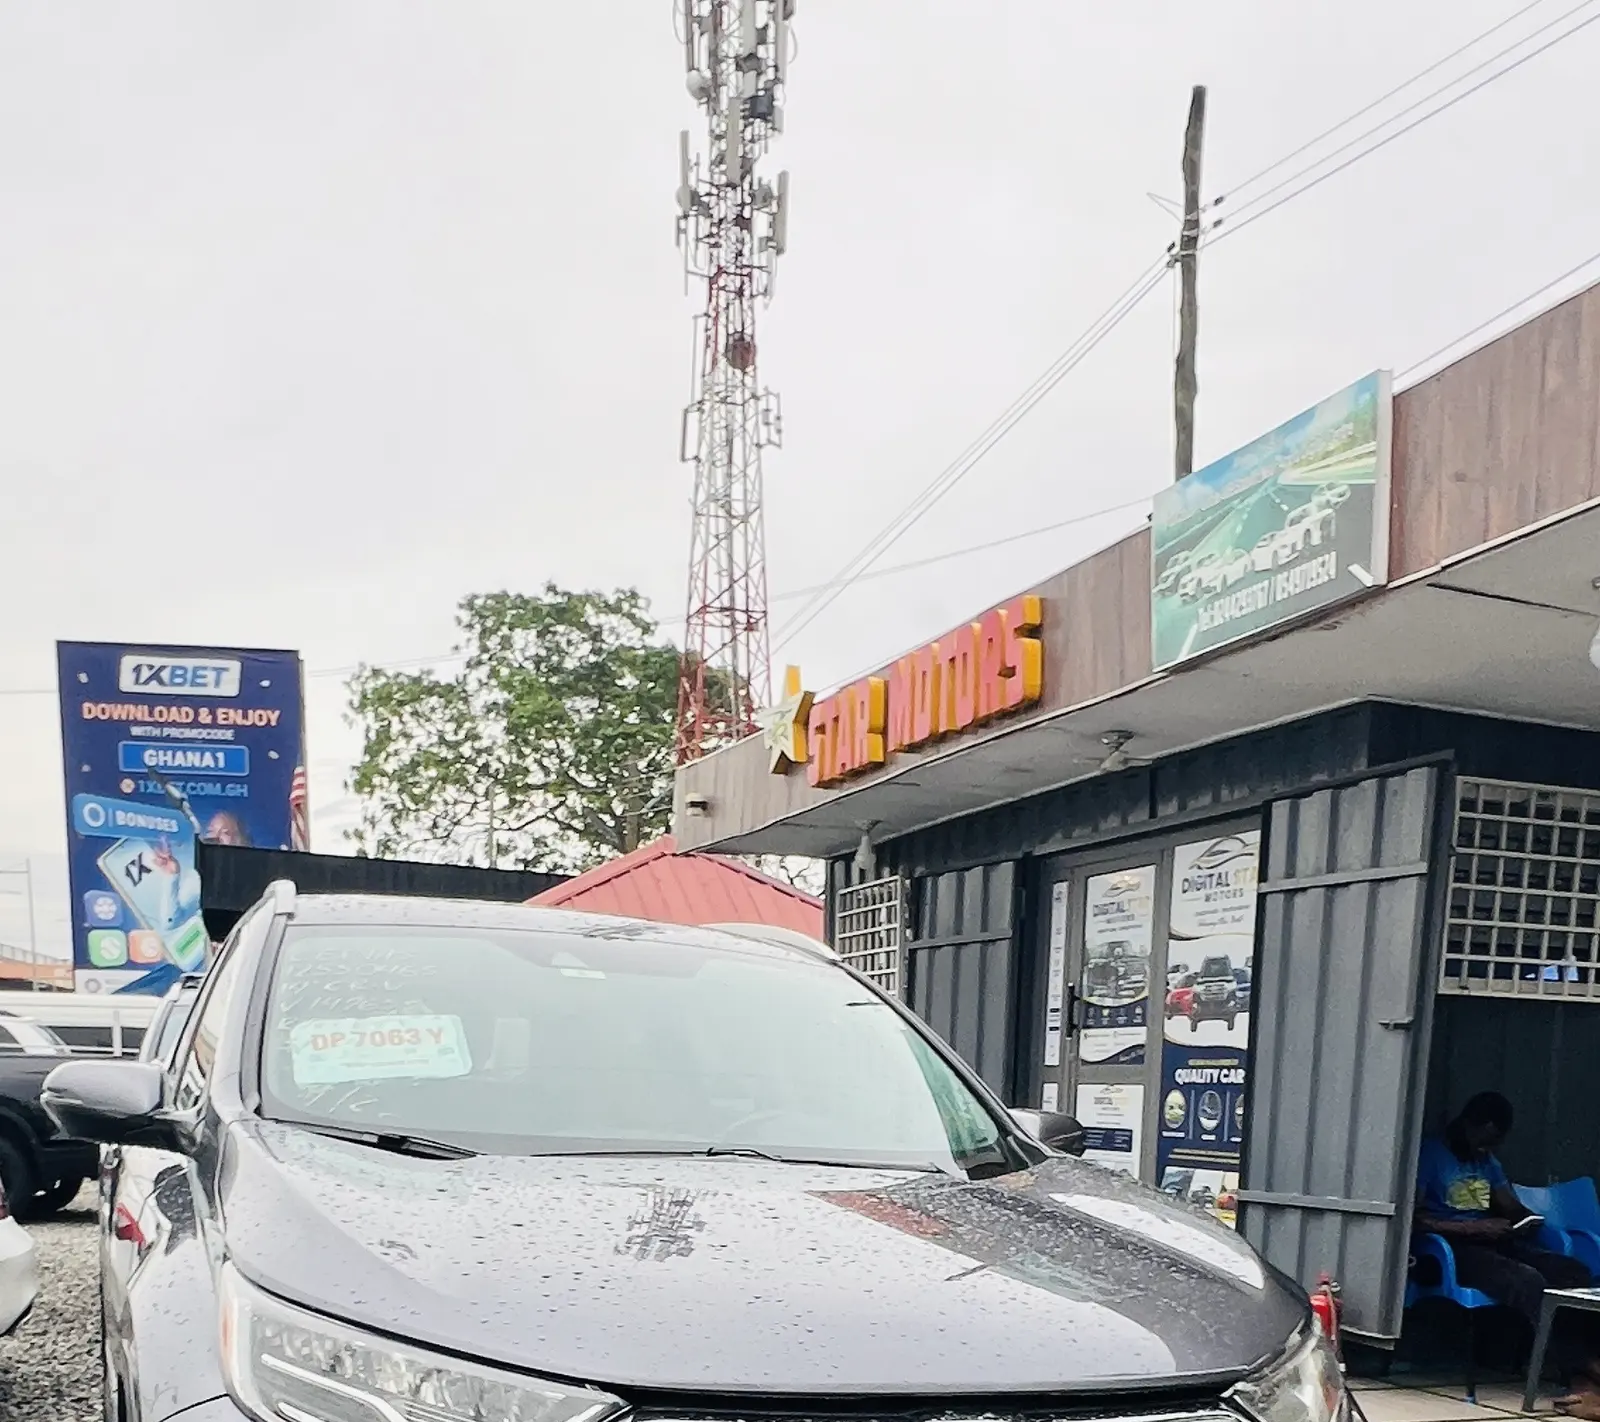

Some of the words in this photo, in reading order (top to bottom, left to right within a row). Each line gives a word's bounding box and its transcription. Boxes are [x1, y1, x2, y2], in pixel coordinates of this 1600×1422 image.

[132, 663, 230, 689] 1XBET
[807, 676, 885, 787] STAR
[886, 595, 1043, 752] MOTORS
[82, 702, 194, 723] DOWNLOAD
[197, 706, 213, 724] &
[216, 707, 281, 726] ENJOY
[129, 725, 162, 737] WITH
[162, 727, 236, 741] PROMOCODE
[143, 749, 226, 768] GHANA1
[115, 810, 179, 833] BONUSES
[1182, 871, 1231, 894] DIGITAL
[354, 1028, 421, 1047] 7063
[424, 1027, 445, 1045] Y
[1174, 1068, 1220, 1085] QUALITY
